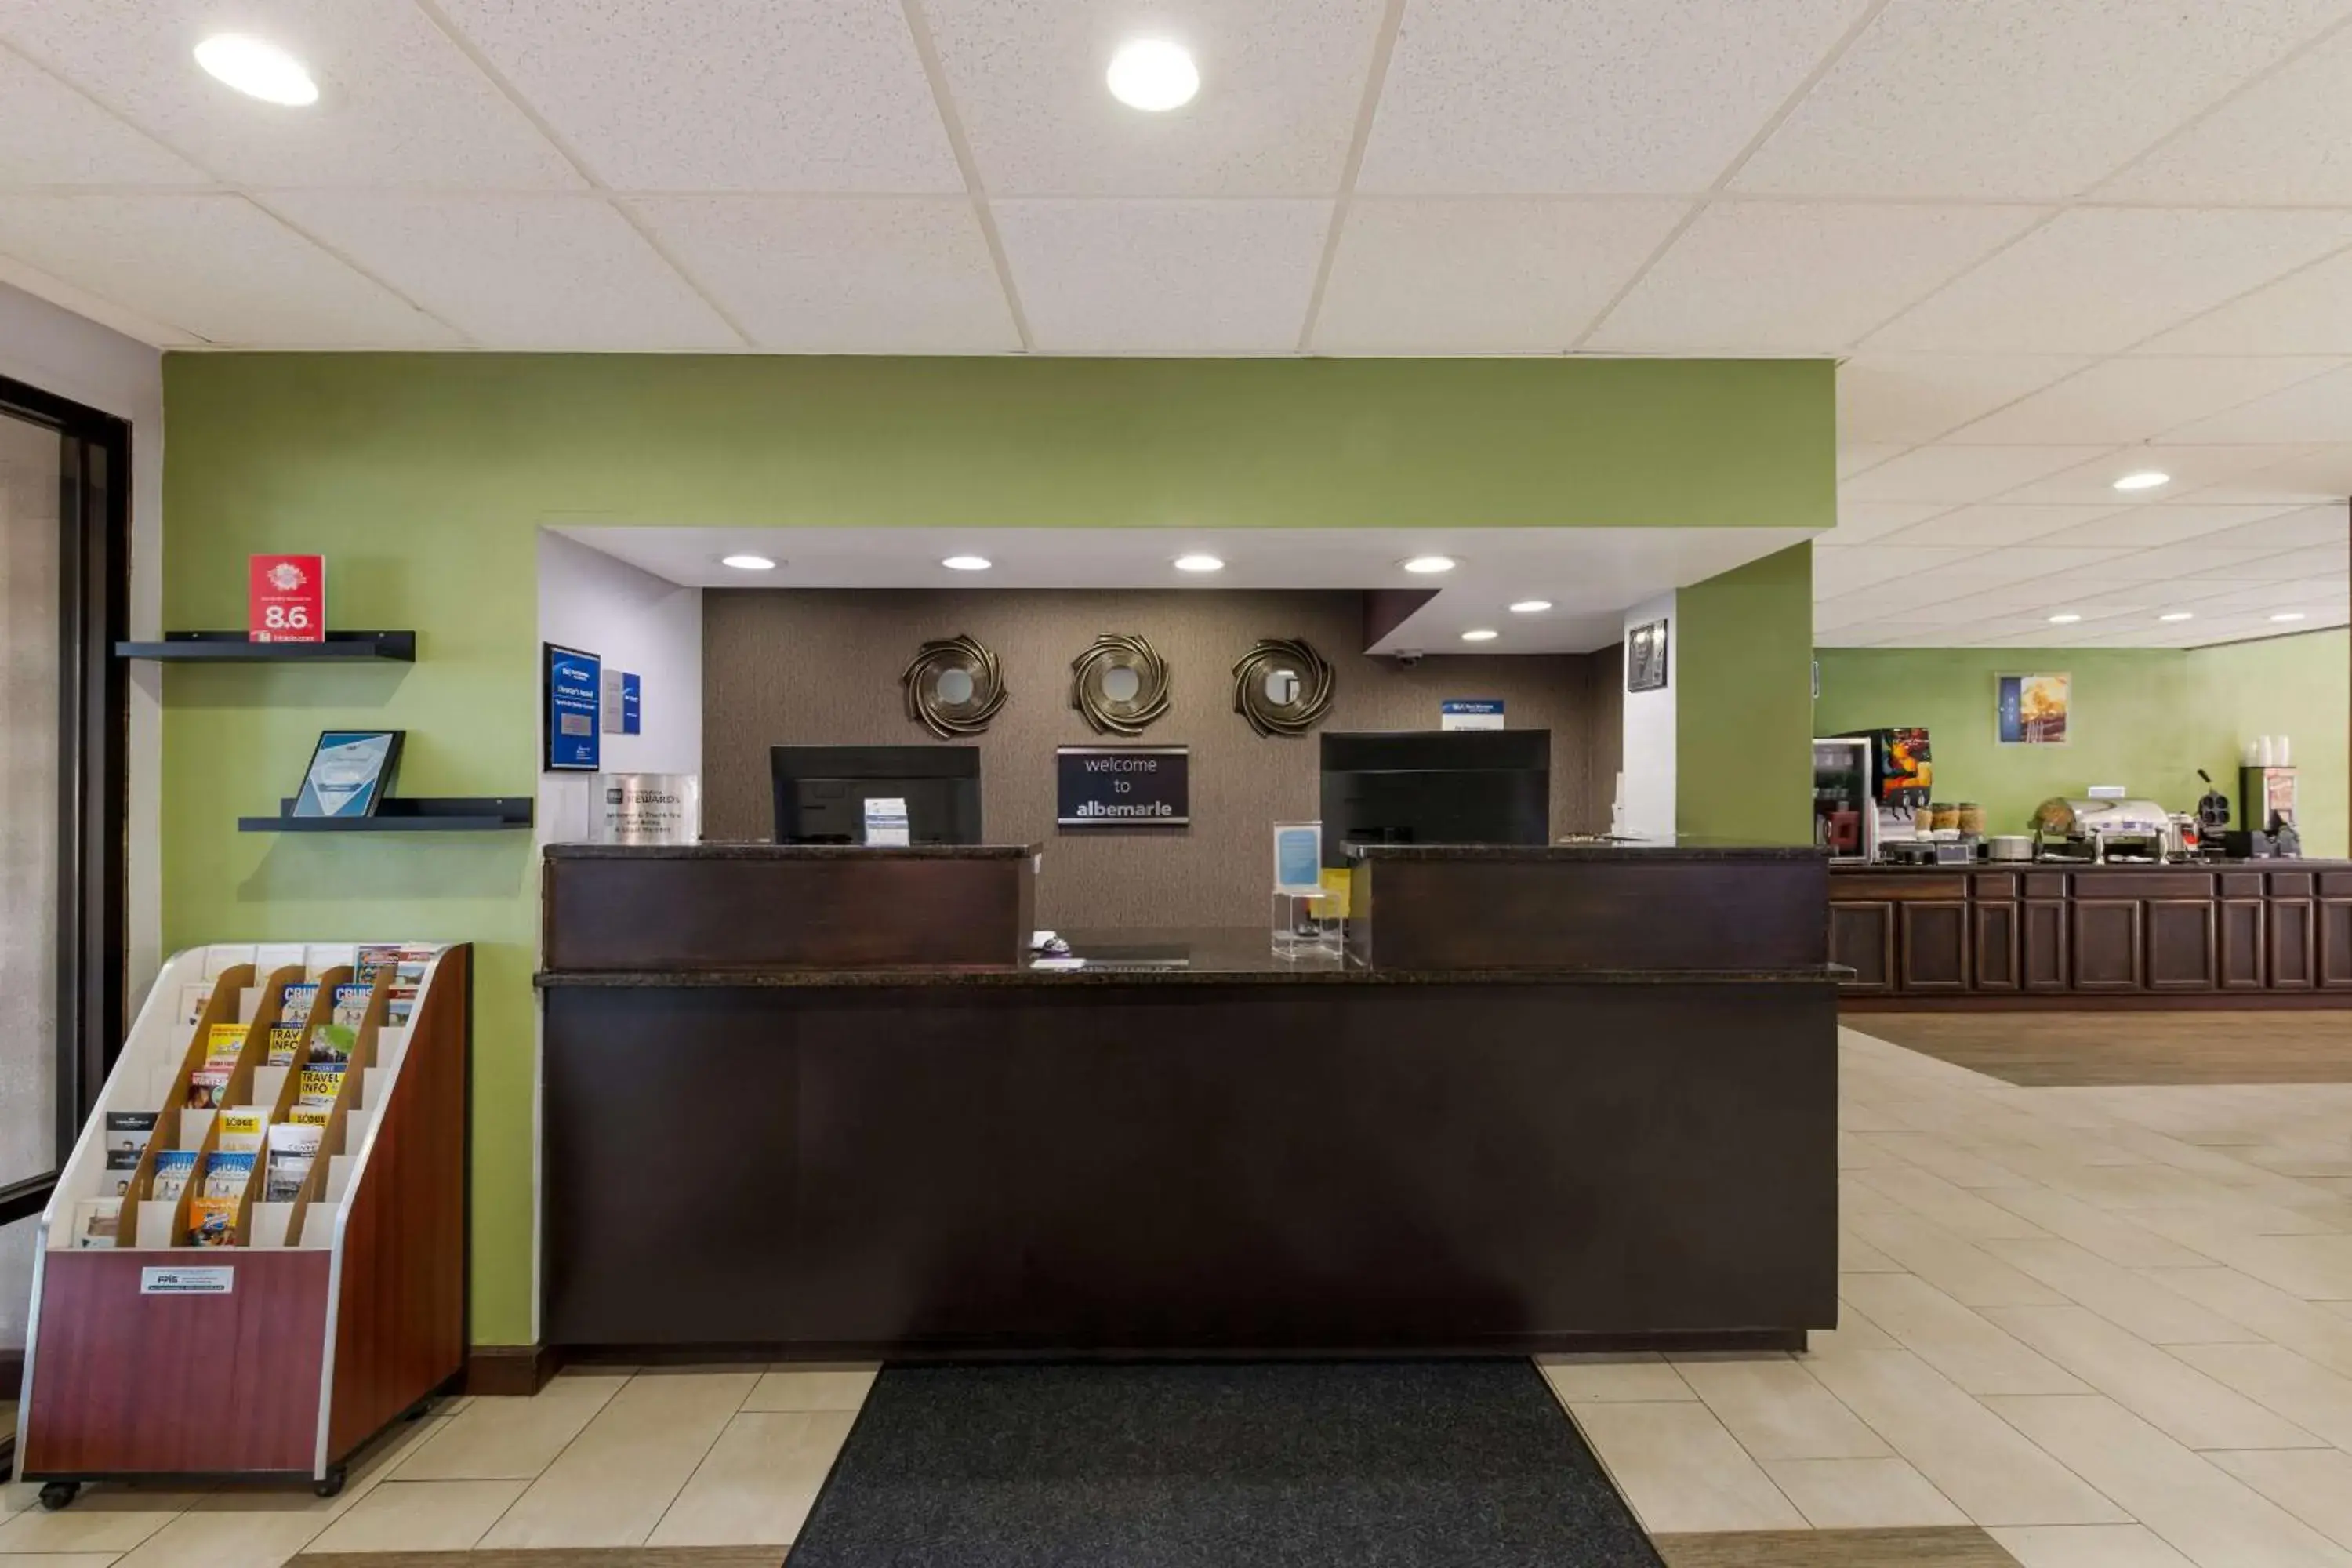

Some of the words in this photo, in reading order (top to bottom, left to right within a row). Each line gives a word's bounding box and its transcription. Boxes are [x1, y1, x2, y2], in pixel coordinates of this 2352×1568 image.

[265, 605, 308, 629] 8.6
[1086, 757, 1157, 772] welcome
[1113, 779, 1131, 793] to
[1076, 800, 1172, 816] albemarle
[302, 1072, 339, 1083] TRAVEL
[302, 1083, 328, 1094] INFO
